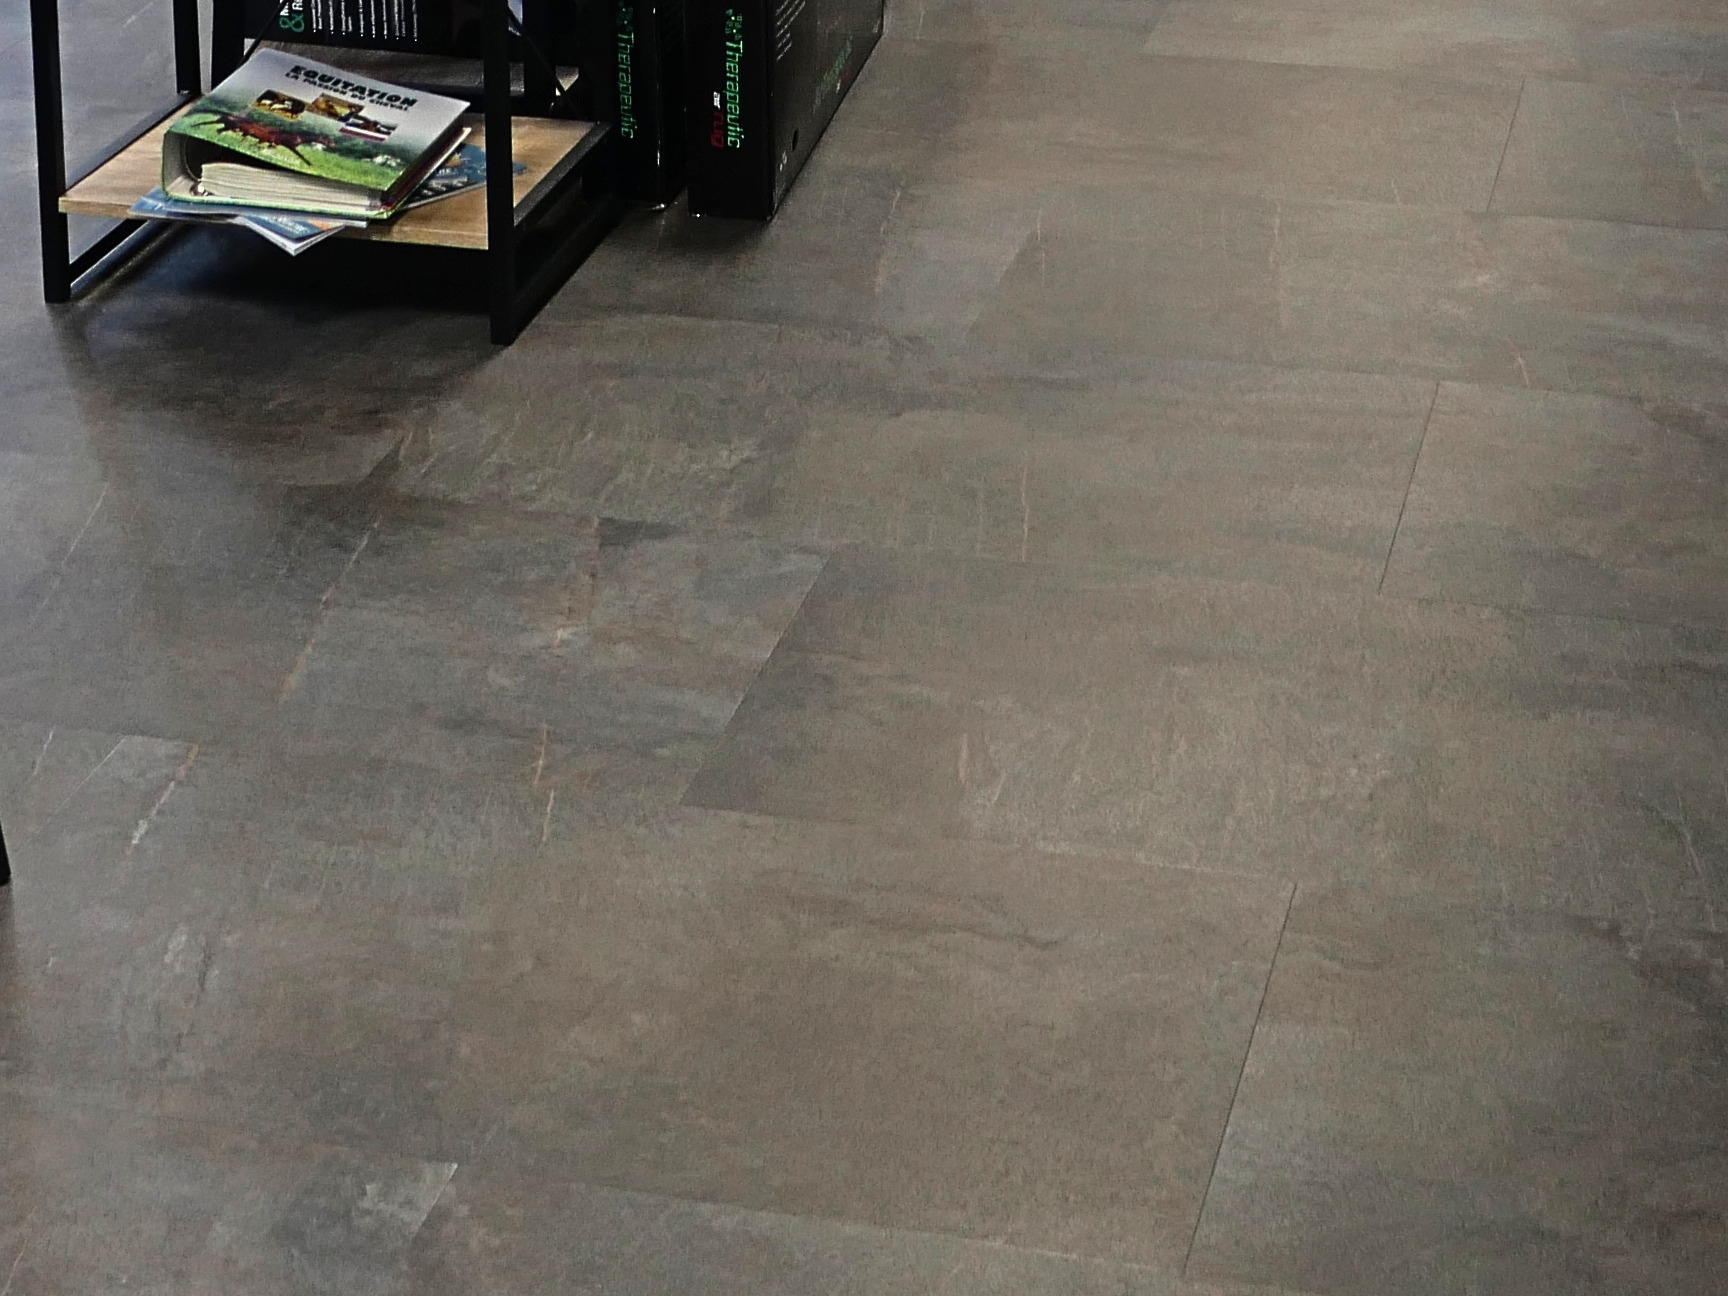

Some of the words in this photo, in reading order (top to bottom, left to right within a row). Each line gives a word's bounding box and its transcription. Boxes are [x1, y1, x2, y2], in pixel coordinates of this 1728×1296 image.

[290, 64, 418, 108] EQUITATION
[616, 30, 637, 140] Therapeutic
[725, 39, 746, 151] Therapeutic
